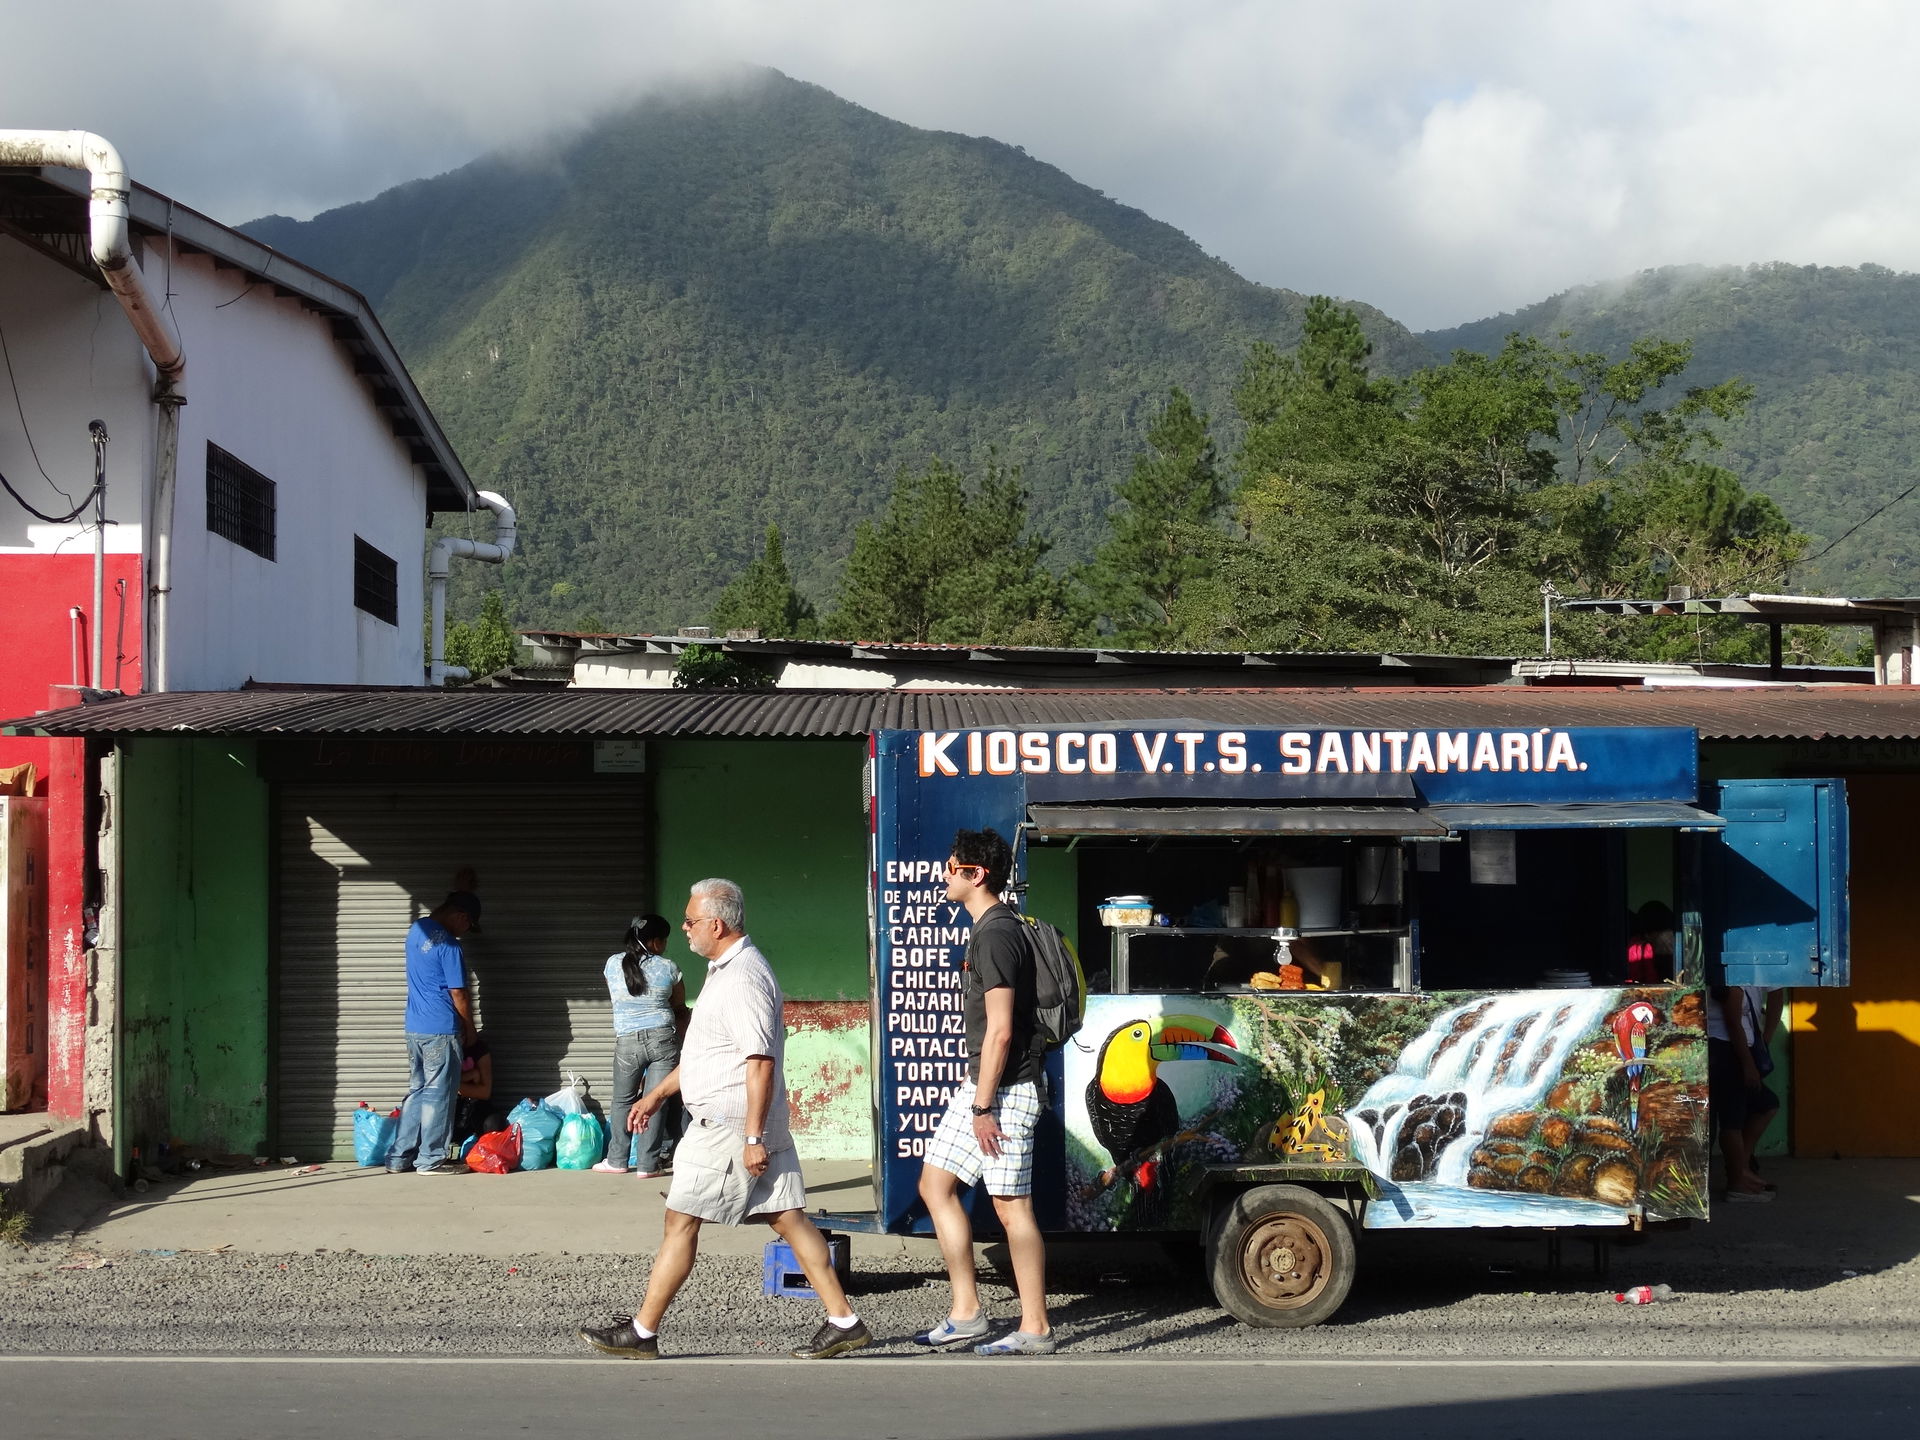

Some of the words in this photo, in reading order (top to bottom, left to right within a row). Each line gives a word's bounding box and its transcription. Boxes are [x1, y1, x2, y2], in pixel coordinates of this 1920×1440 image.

[919, 731, 1117, 777] KIOSCO
[1132, 731, 1263, 775] V.T.S.
[1279, 727, 1588, 775] SANTAMARÍA.
[886, 860, 944, 883] EMPA
[884, 890, 901, 904] DE
[907, 885, 948, 904] MAÍZ
[888, 902, 940, 924] CAFÉ
[947, 906, 960, 924] Y
[891, 926, 970, 946] CARIMA
[892, 948, 951, 968] BOFE
[891, 970, 962, 989] CHICHA
[888, 1013, 937, 1033] POLLO
[891, 1037, 969, 1058] PATACO
[899, 1113, 941, 1132] YUC
